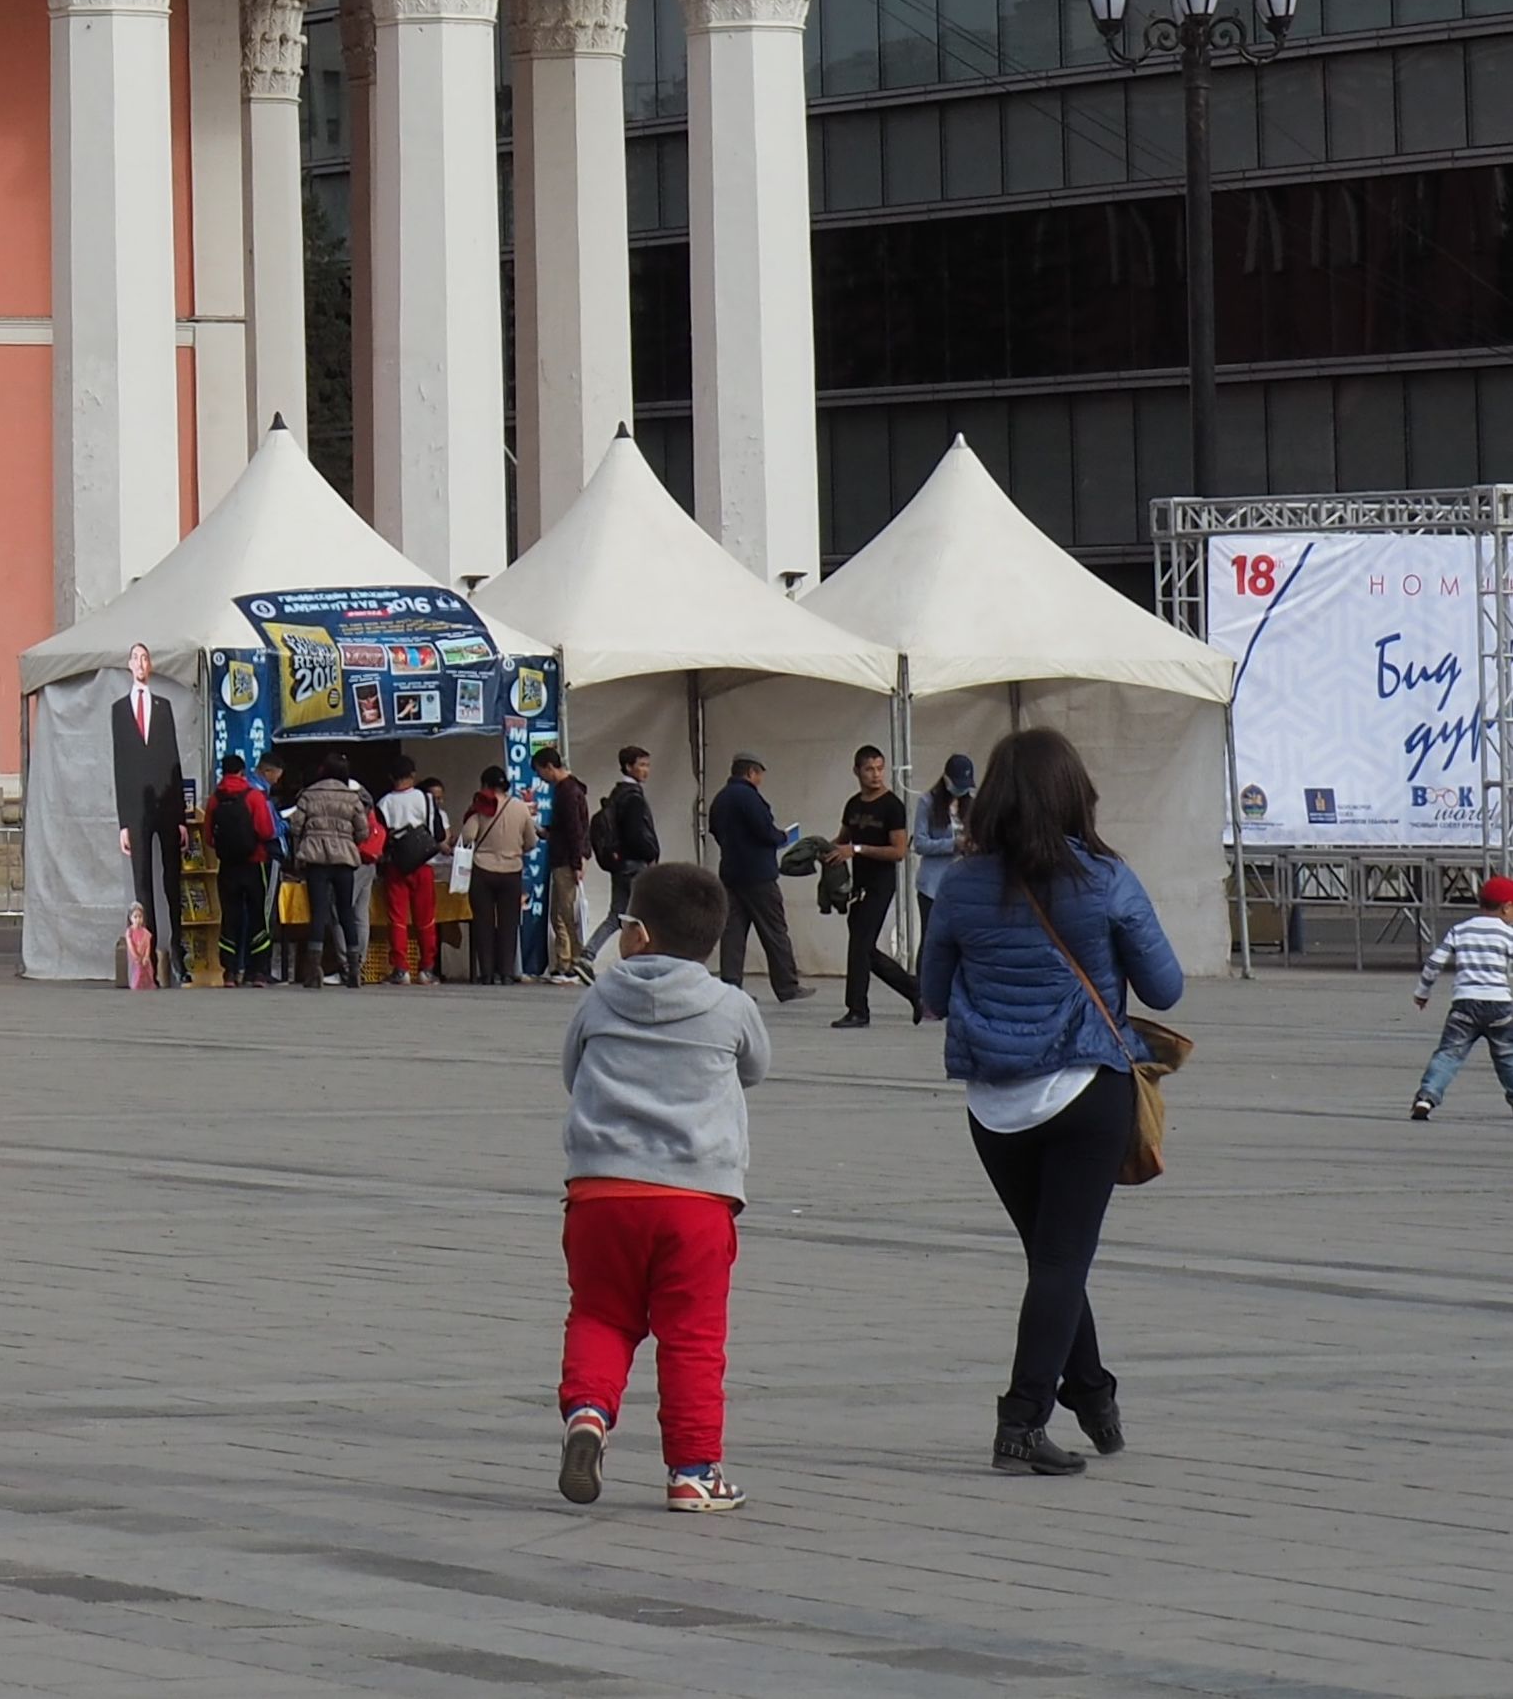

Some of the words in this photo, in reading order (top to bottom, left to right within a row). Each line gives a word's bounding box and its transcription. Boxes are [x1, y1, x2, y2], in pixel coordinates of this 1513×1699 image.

[383, 596, 432, 614] 2016
[294, 667, 338, 703] 2016
[1375, 632, 1462, 712] Бид
